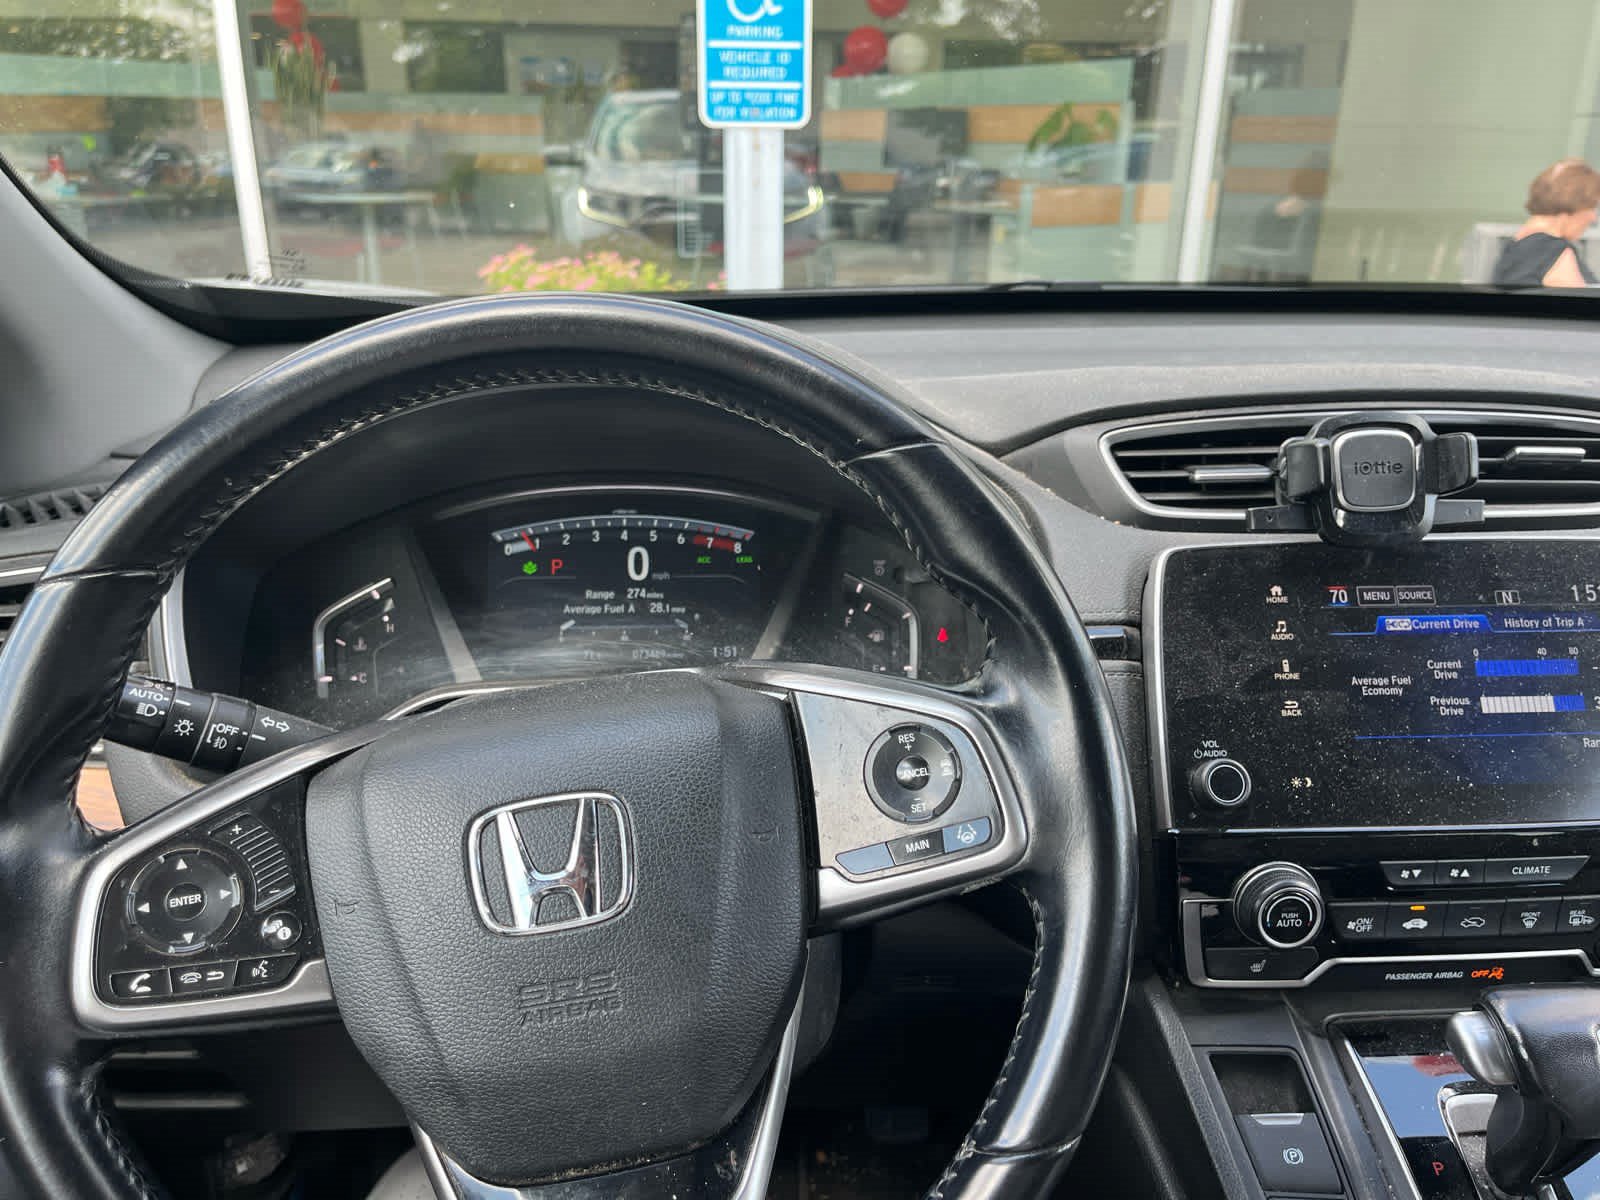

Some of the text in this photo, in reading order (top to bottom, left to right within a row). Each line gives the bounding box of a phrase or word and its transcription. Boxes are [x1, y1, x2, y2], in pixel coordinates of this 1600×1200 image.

[726, 24, 784, 39] PARKING
[719, 50, 771, 64] VEHICLE
[723, 66, 788, 80] REQUIRED
[504, 530, 742, 556] 0 1 2 3 4 5 6 7 8
[551, 559, 563, 575] P
[627, 546, 671, 582] 0 mph
[585, 590, 616, 601] Range
[627, 588, 646, 599] 274
[1329, 590, 1348, 603] 70
[1363, 591, 1390, 601] MENU
[1399, 591, 1433, 600] SOURCE
[563, 604, 602, 616] Average
[604, 603, 625, 614] Fuel
[628, 603, 636, 613] A
[649, 602, 669, 613] 28.1
[1412, 619, 1480, 630] Current Drive
[1503, 618, 1584, 630] History of Trip A
[712, 646, 737, 657] 1:51
[1473, 648, 1479, 656] 0
[1427, 660, 1462, 669] Current
[1352, 675, 1411, 687] Average Fuel
[1434, 671, 1458, 680] Drive
[129, 688, 163, 701] AUTO
[1362, 687, 1403, 697] Economy
[1430, 696, 1470, 706] Previous
[1281, 709, 1302, 717] BACK
[1440, 707, 1464, 716] Drive
[216, 723, 239, 735] OFF
[898, 733, 915, 744] RES
[1201, 740, 1219, 748] VOL
[911, 803, 927, 814] SET
[905, 839, 929, 853] MAIN
[1511, 865, 1551, 876] CLIMATE
[169, 893, 202, 908] ENTER
[1277, 919, 1302, 927] AUTO
[1356, 917, 1373, 925] ON/
[1385, 971, 1463, 980] PASSENGER AIRBAG
[1471, 969, 1490, 978] OFF
[1432, 1161, 1444, 1176] P
